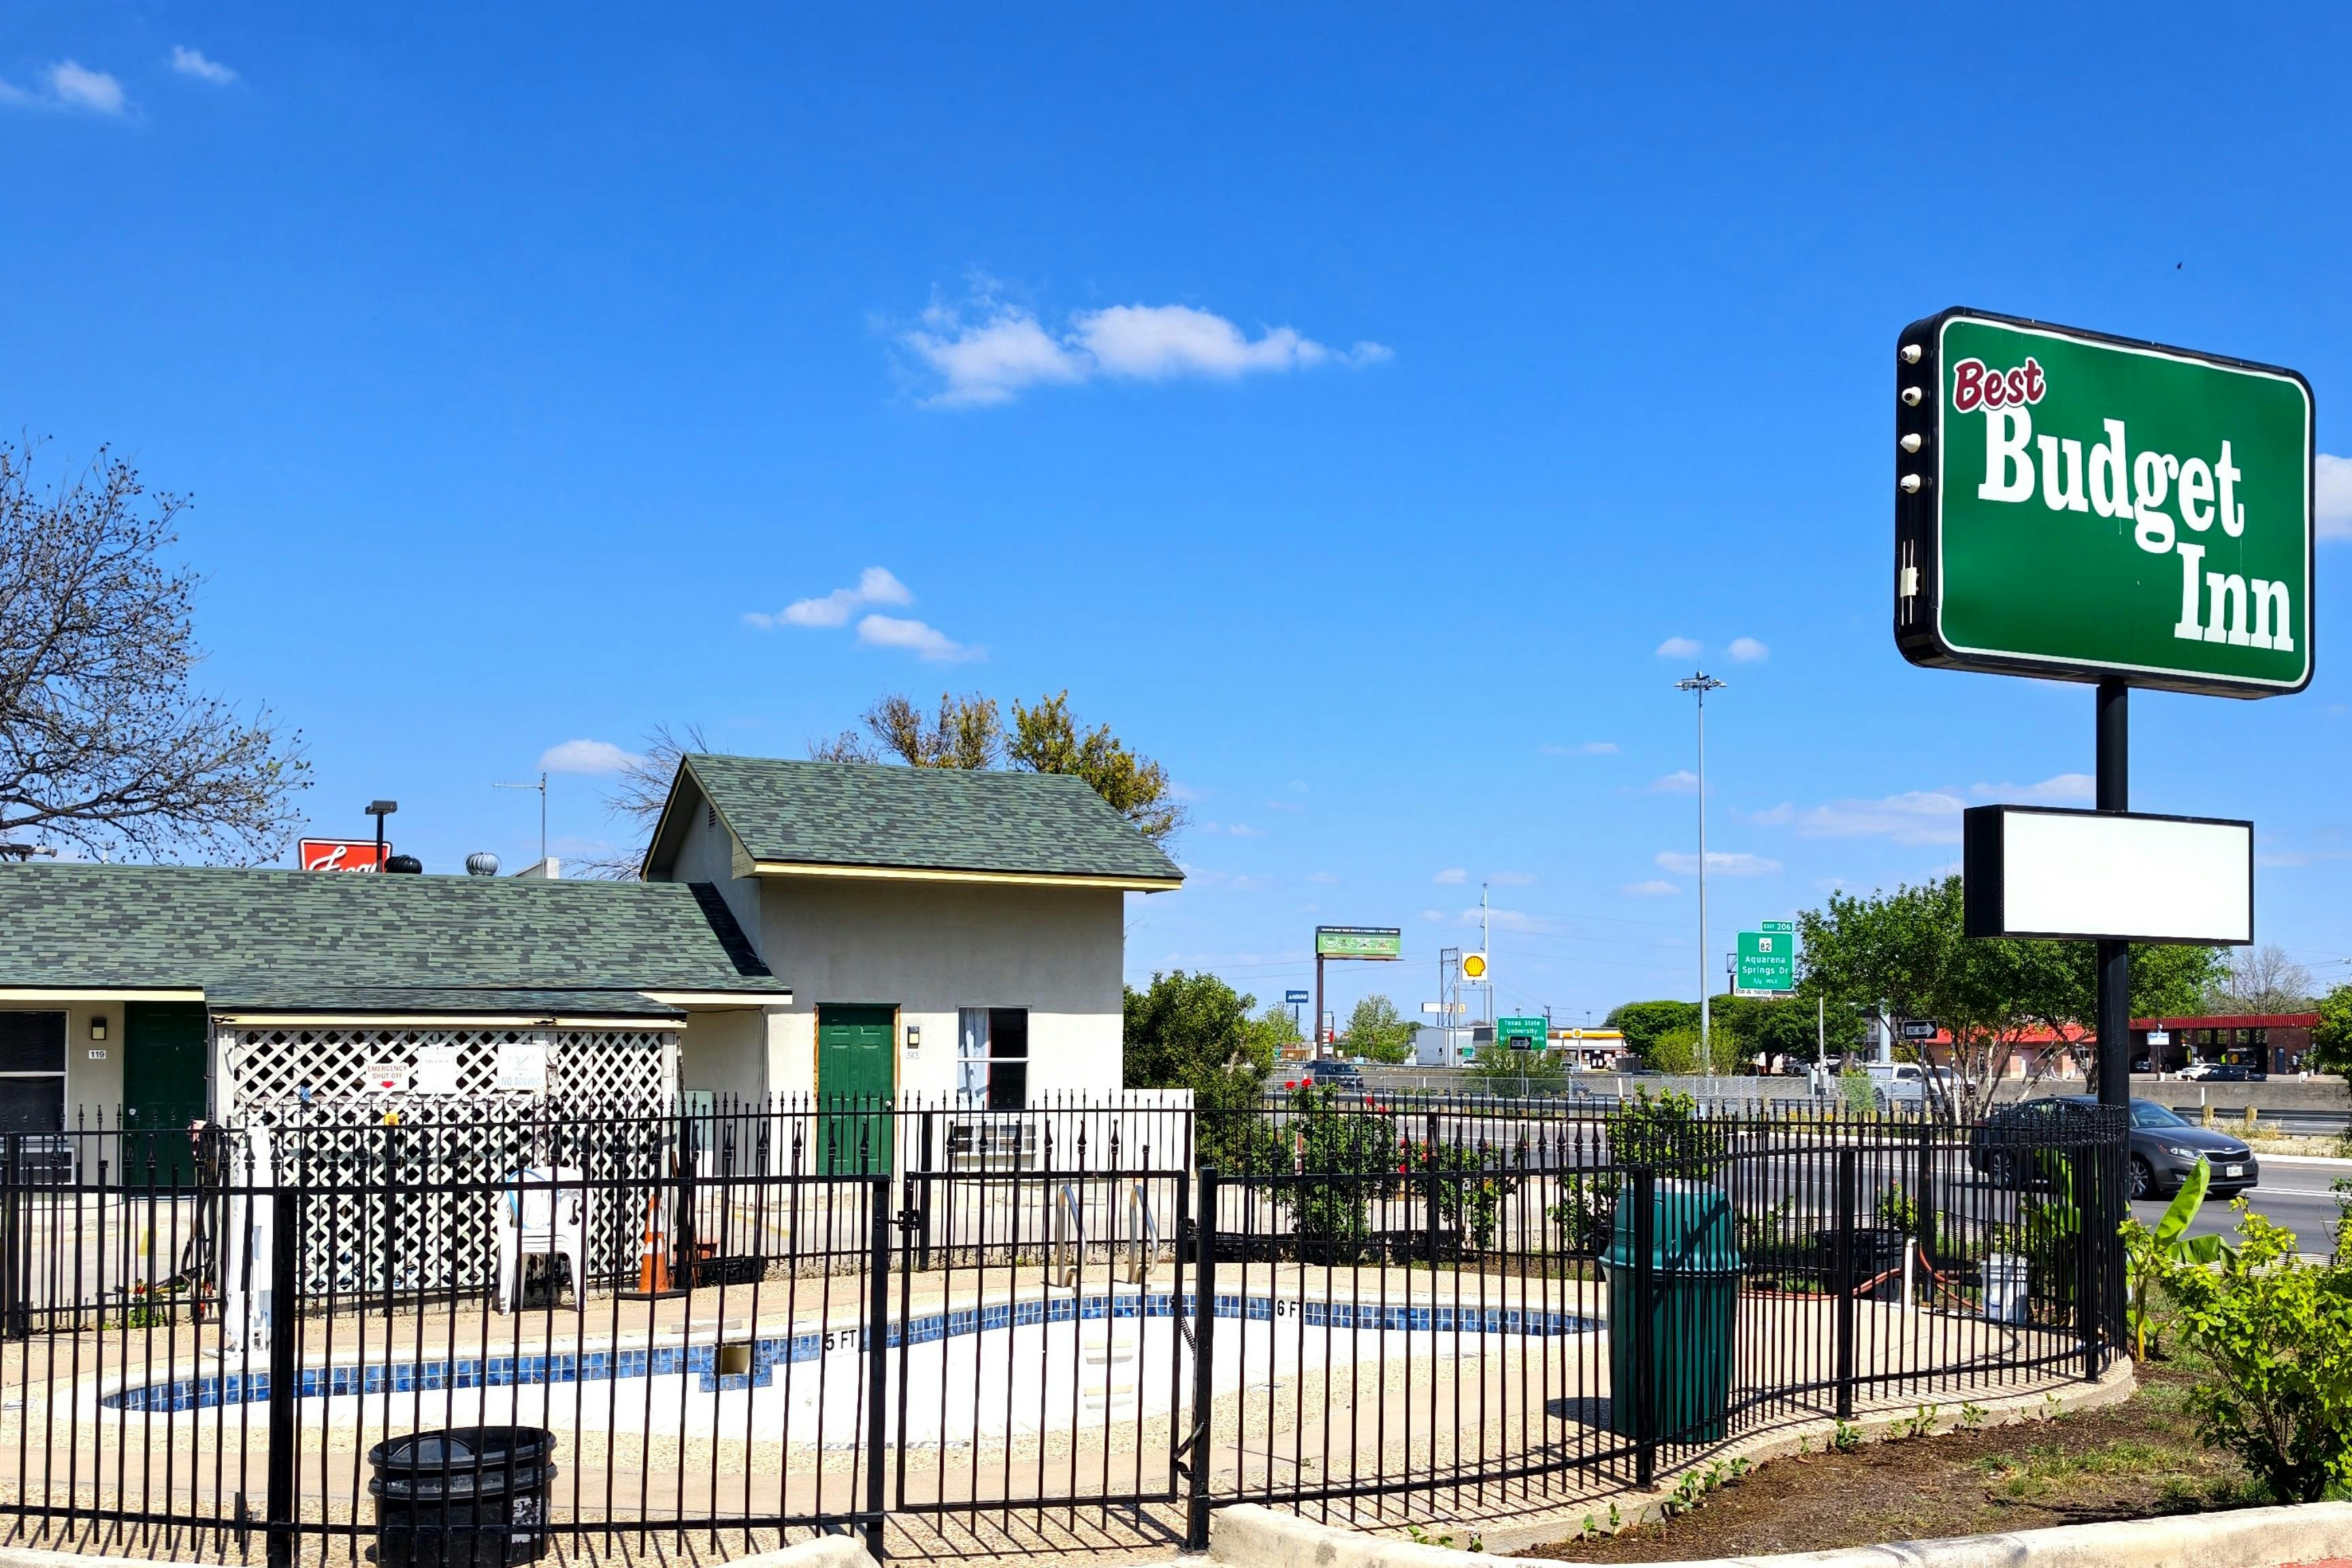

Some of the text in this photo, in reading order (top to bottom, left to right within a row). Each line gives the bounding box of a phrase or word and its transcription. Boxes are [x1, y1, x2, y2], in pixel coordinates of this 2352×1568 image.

[1954, 357, 2046, 412] Best
[1978, 406, 2244, 554] Budget
[2174, 542, 2294, 651] Inn
[1760, 943, 1771, 951] 82
[1745, 955, 1786, 964] Aquarena
[1742, 966, 1788, 975] Springs Dr
[368, 1064, 407, 1073] EMERGENCY
[502, 1077, 541, 1086] NO DIVING
[1277, 1299, 1285, 1316] 6
[826, 1329, 857, 1351] 5 FT
